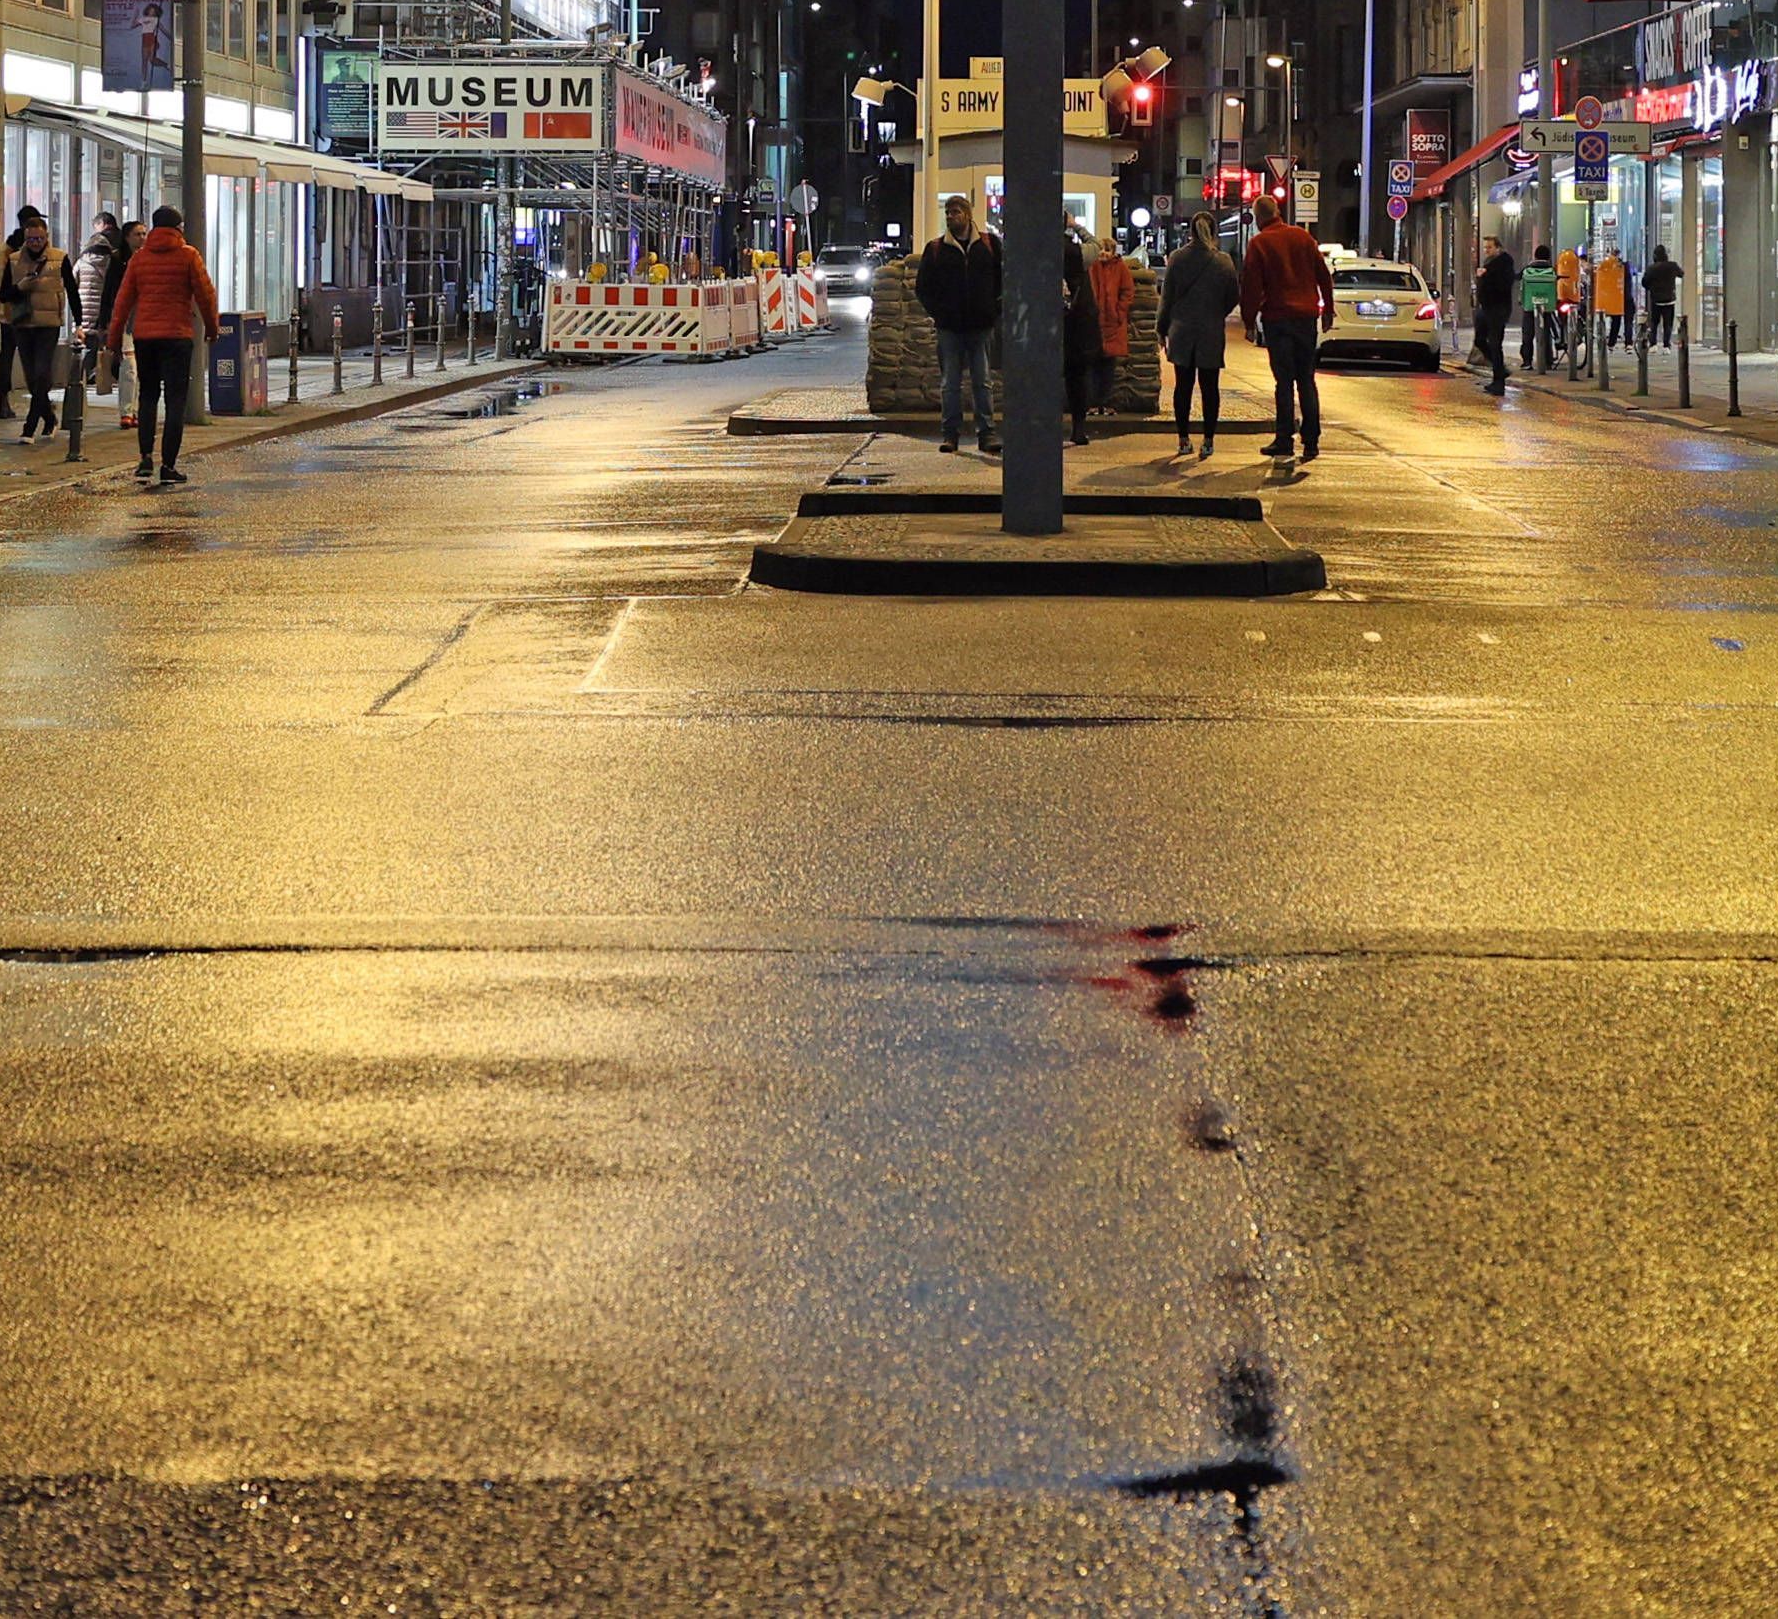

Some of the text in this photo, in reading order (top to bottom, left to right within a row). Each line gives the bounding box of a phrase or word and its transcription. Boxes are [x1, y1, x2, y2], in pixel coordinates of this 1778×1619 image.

[1644, 16, 1674, 82] SNACKS
[1683, 1, 1713, 73] COFFEE
[386, 77, 593, 107] MUSEUM
[942, 91, 951, 113] S
[958, 91, 999, 113] ARMY
[1412, 134, 1446, 143] SOTTO
[1412, 143, 1446, 152] SOPRA
[1577, 165, 1605, 179] TAXI
[1390, 184, 1411, 194] TAXI
